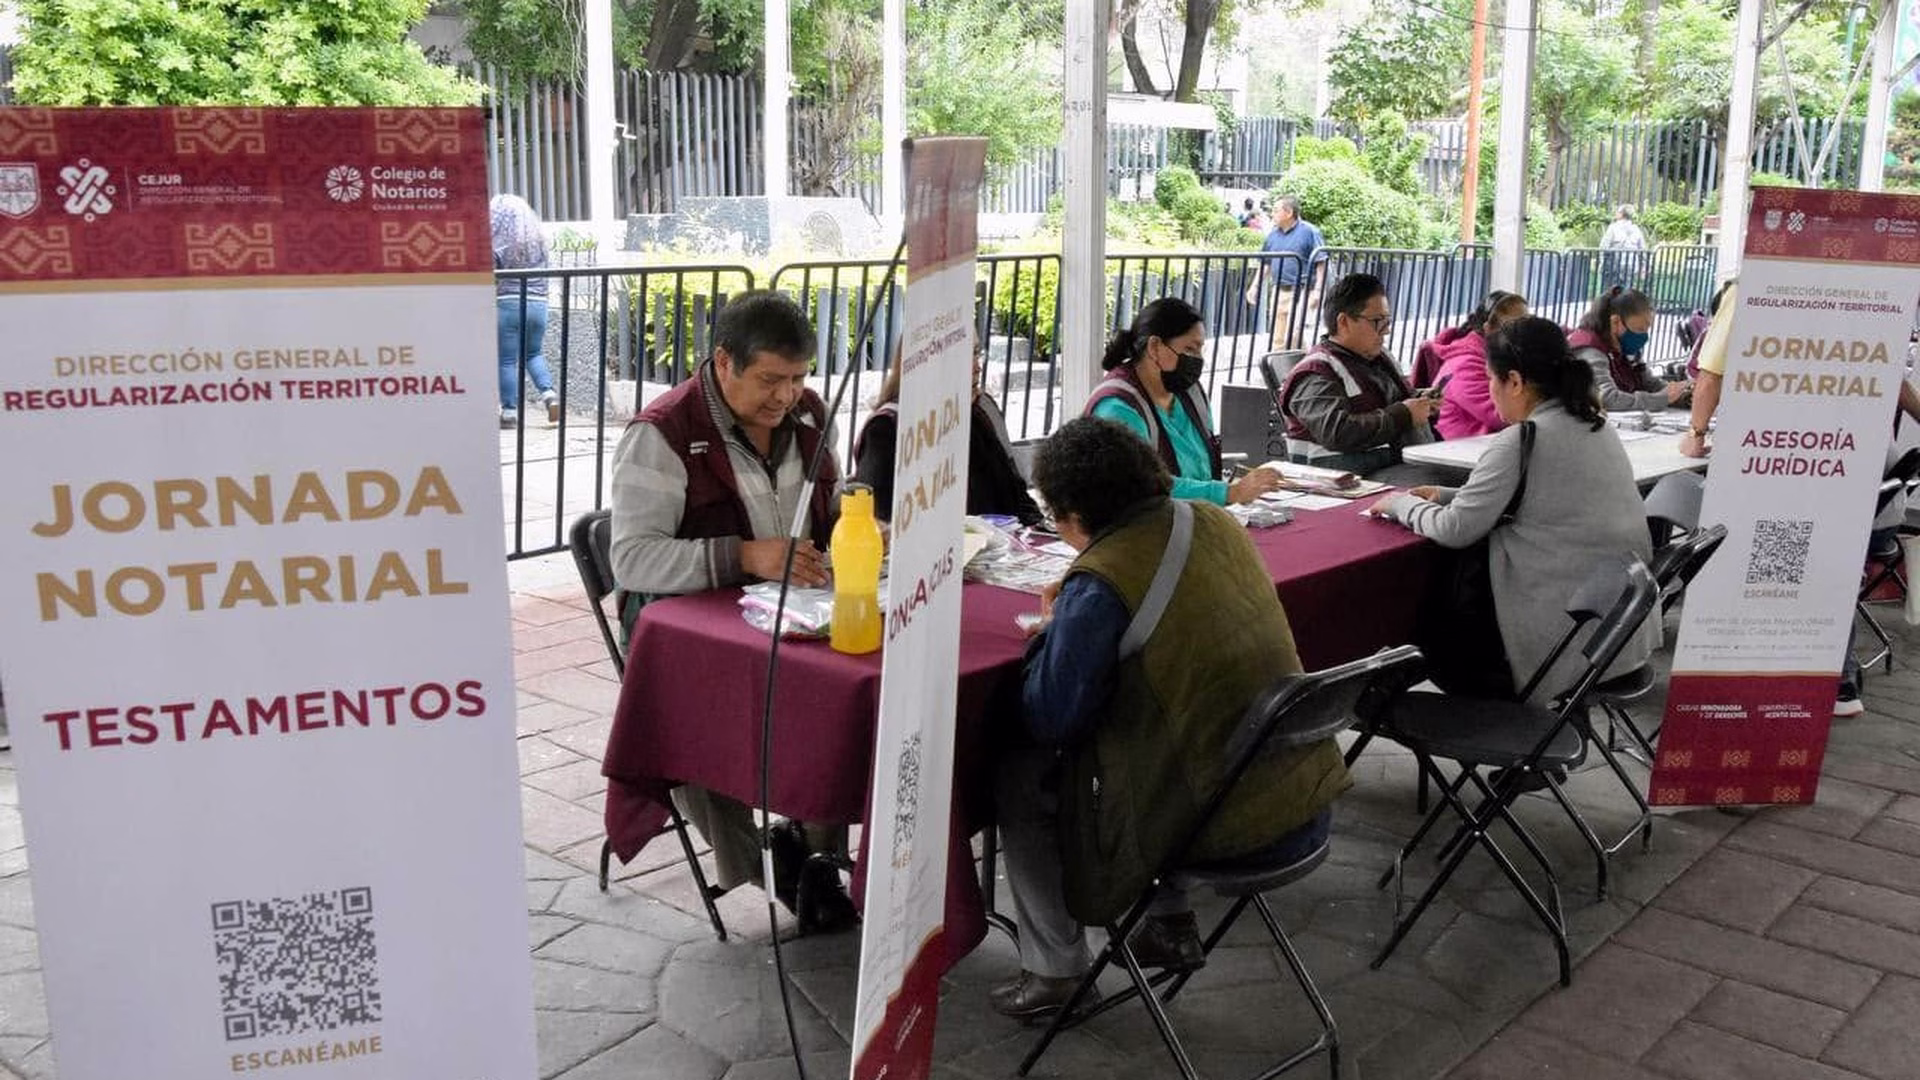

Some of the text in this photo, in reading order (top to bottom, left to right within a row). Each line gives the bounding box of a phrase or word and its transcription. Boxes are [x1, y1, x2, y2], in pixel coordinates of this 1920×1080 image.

[138, 174, 182, 185] CEJUR
[371, 166, 446, 183] Colegio de
[372, 183, 448, 199] Notarios
[1746, 296, 1903, 314] REGULARIZACIÓN TERRITORIAL
[1824, 288, 1872, 299] GENERAL
[55, 346, 415, 378] DIRECCIÓN GENERAL DE
[1741, 336, 1889, 364] JORNADA
[4, 375, 465, 411] REGULARIZACIÓN TERRITORIAL
[1734, 371, 1884, 398] NOTARIAL
[1741, 428, 1855, 451] ASESORÍA
[1741, 453, 1846, 477] JURÍDICA
[31, 465, 463, 538] JORNADA
[36, 548, 469, 622] NOTARIAL
[43, 680, 487, 751] TESTAMENTOS
[231, 1036, 383, 1072] ESCANÉAME
